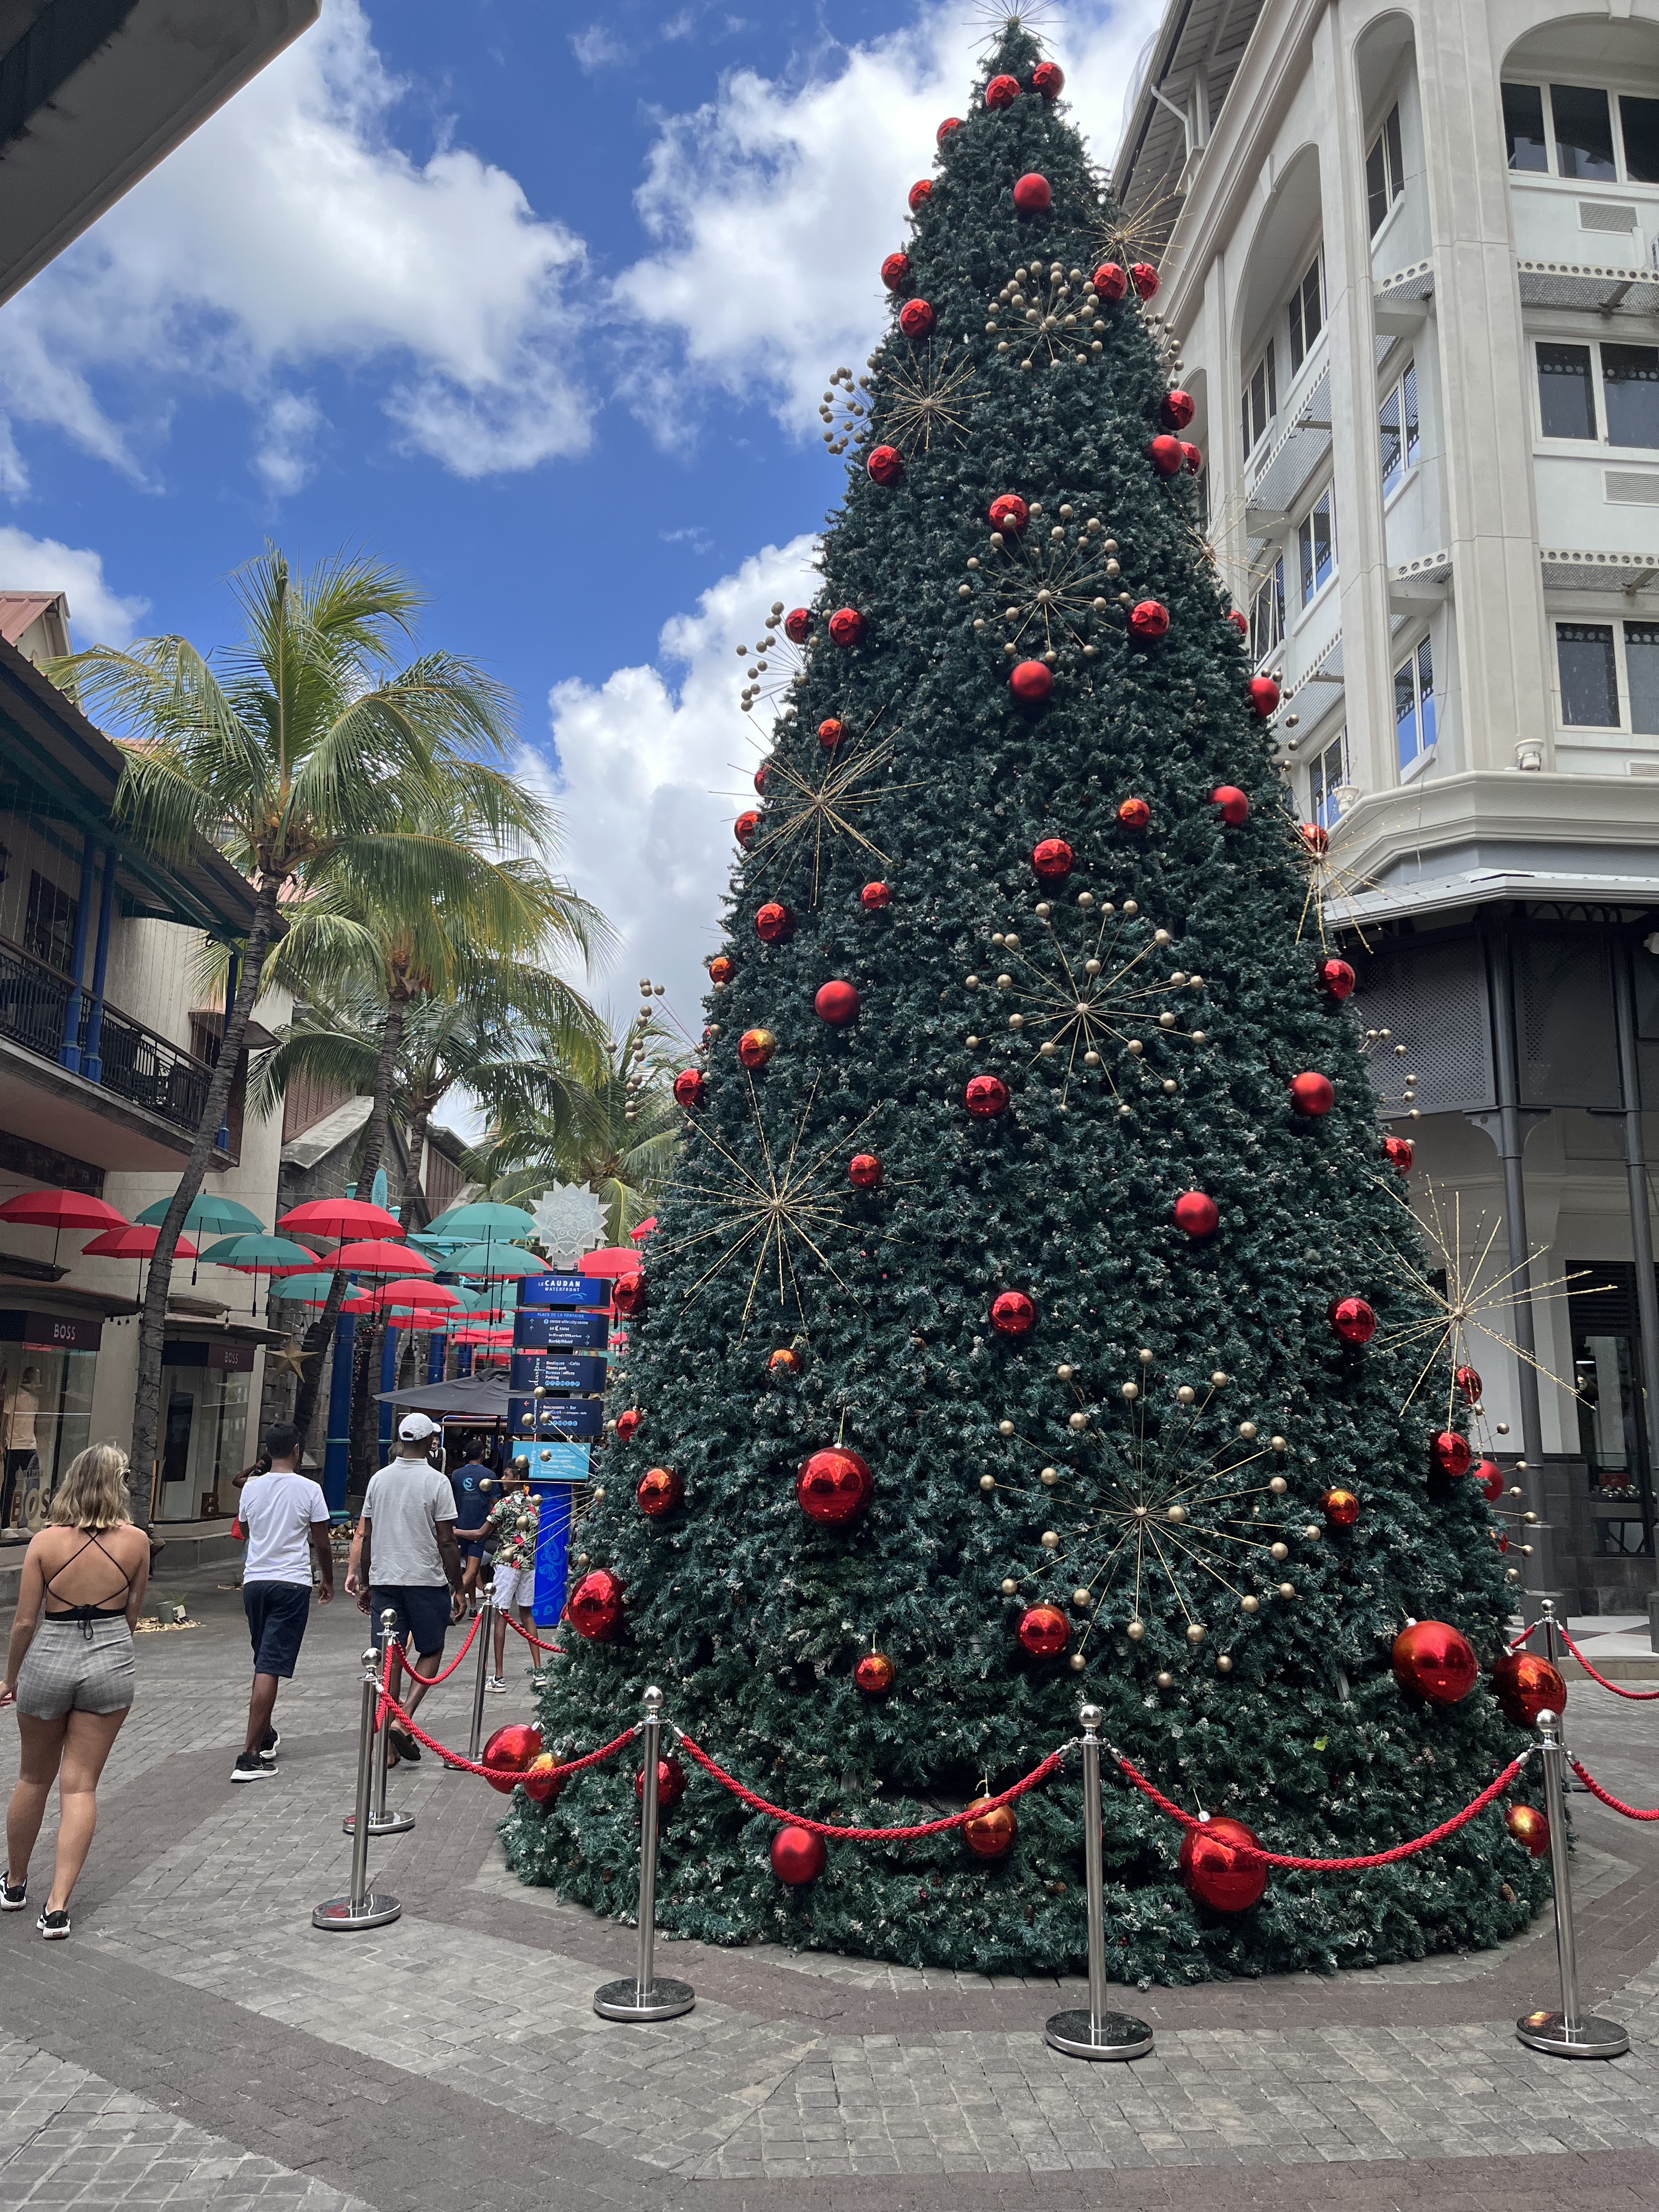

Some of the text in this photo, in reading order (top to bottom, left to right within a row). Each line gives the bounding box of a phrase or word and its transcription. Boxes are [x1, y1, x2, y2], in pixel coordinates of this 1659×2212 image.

[54, 1323, 76, 1340] BOSS
[225, 1352, 238, 1364] BOSS
[10, 1488, 59, 1521] BOS
